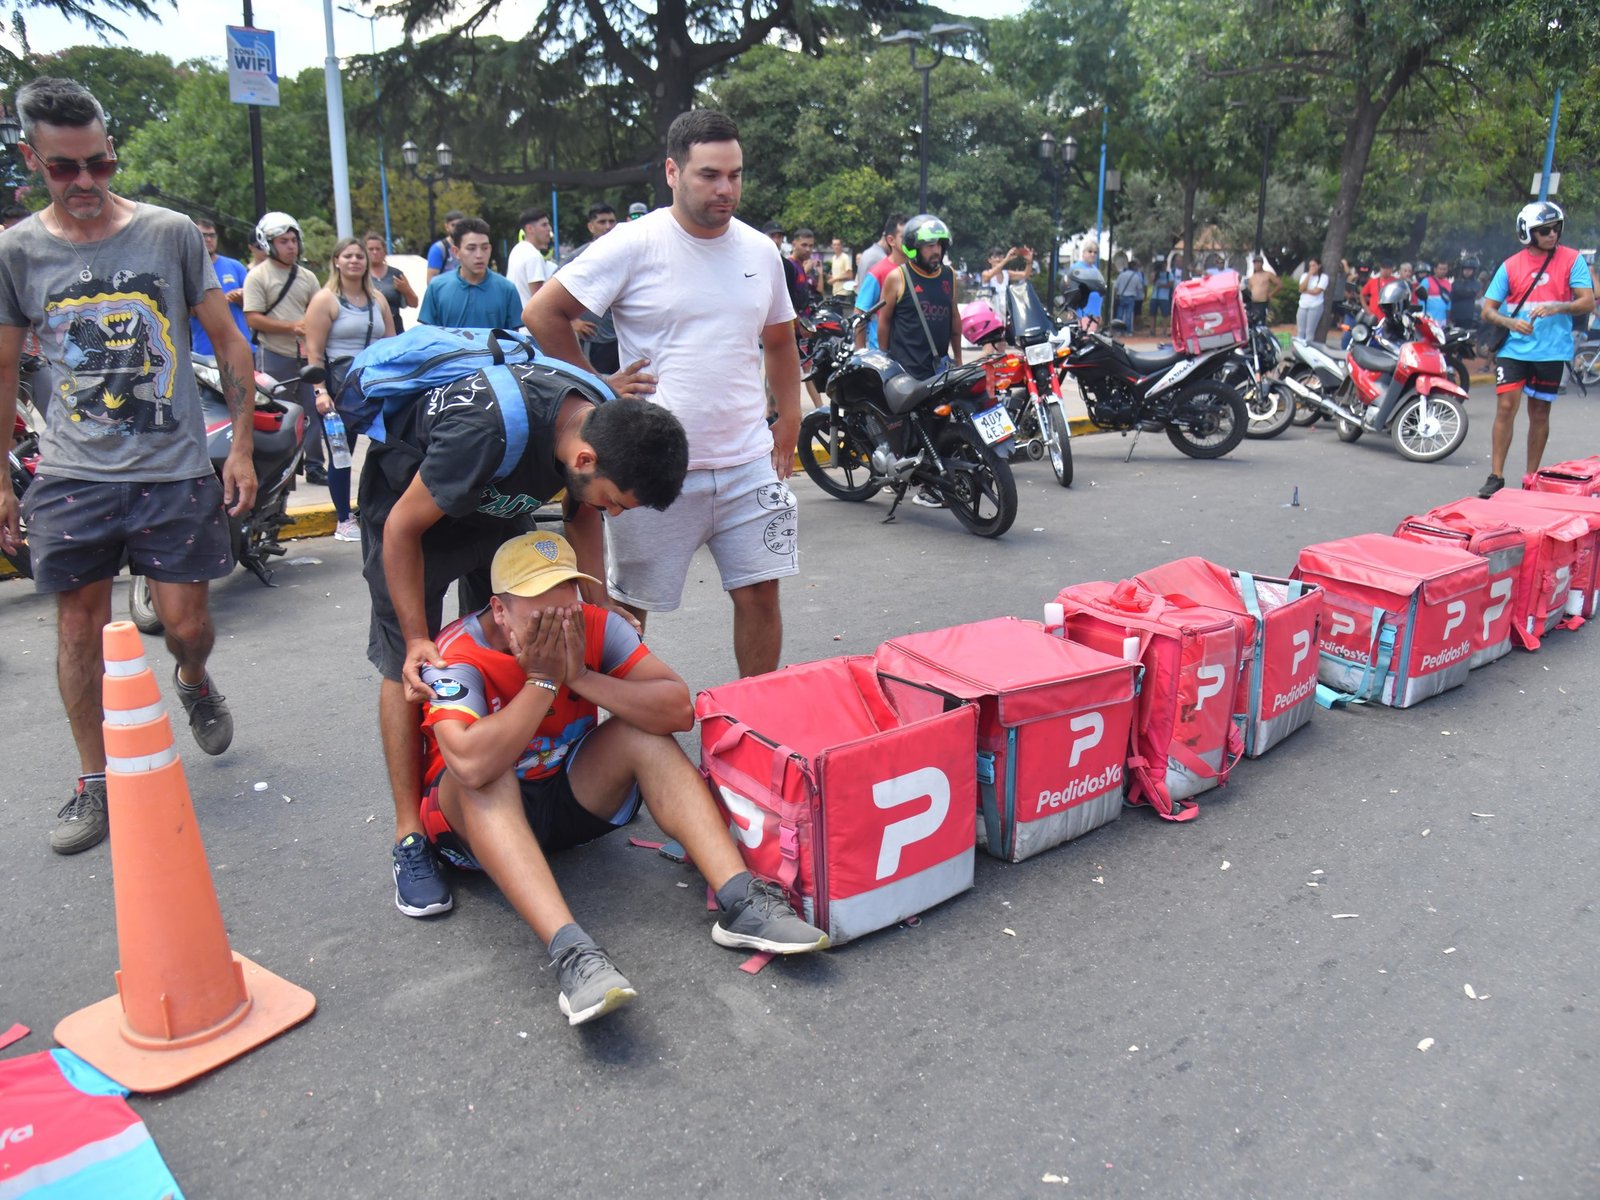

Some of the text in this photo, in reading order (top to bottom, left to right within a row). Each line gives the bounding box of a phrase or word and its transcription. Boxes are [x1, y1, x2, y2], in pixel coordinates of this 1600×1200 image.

[233, 47, 255, 55] ZONA
[234, 55, 271, 73] WIFI
[1443, 600, 1466, 641] P
[1320, 640, 1370, 663] edidosYa
[1420, 640, 1471, 672] PedidosYa
[1069, 711, 1104, 768] P
[1036, 763, 1122, 813] PedidosYa
[872, 766, 951, 881] P
